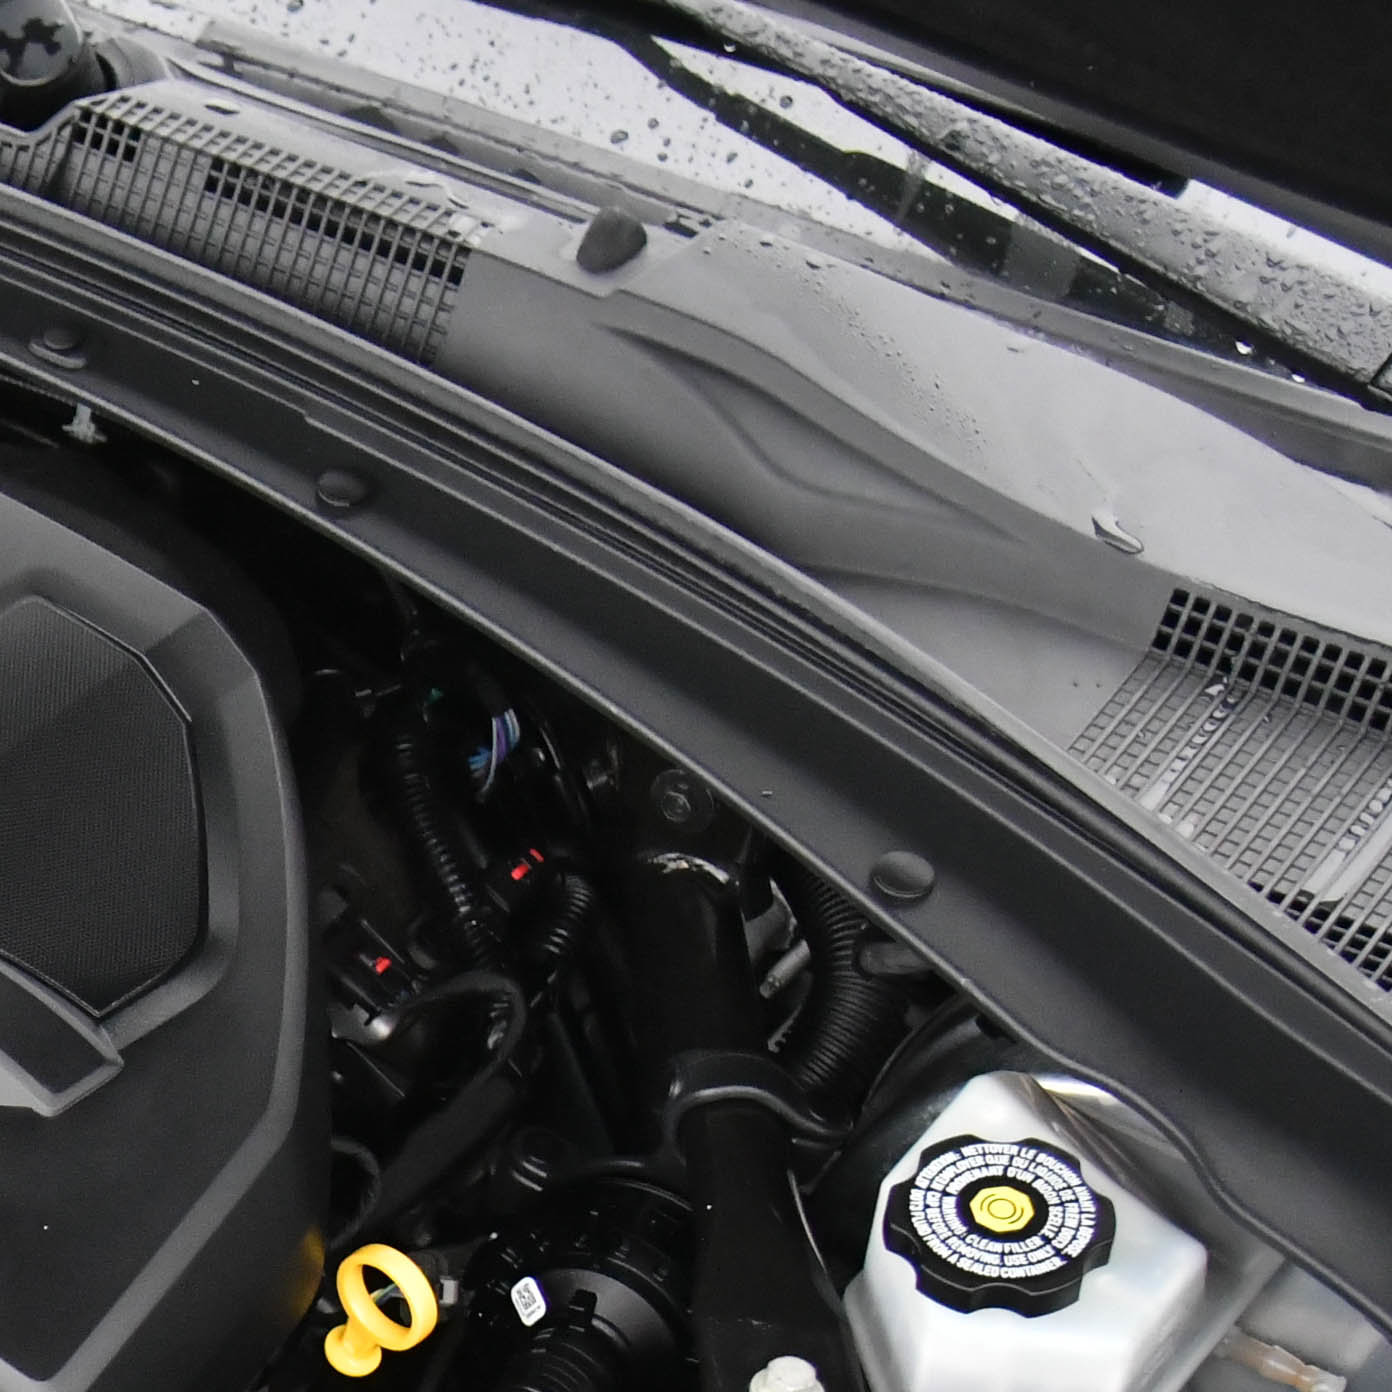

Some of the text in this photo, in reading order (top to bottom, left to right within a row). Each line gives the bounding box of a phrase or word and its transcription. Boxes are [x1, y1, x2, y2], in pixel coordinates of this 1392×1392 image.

[960, 1142, 1020, 1157] NETTOYER
[1019, 1147, 1038, 1160] LE
[985, 1154, 1011, 1166] QUE
[1011, 1156, 1030, 1170] DU
[1028, 1162, 1068, 1190] LIQUIDE
[1035, 1153, 1083, 1187] BOUCHON
[945, 1165, 1005, 1195] PROVENANT
[1007, 1167, 1036, 1183] D'UN
[1032, 1179, 1062, 1205] BIDON
[925, 1191, 943, 1207] CAP
[1059, 1189, 1076, 1201] DE
[1072, 1186, 1096, 1212] AVANT
[925, 1208, 954, 1240] BEFORE
[1064, 1203, 1081, 1228] FREIN
[1080, 1213, 1096, 1226] LA
[910, 1211, 933, 1236] FLUID
[923, 1234, 954, 1258] FROM
[947, 1253, 960, 1264] A
[956, 1257, 1000, 1277] SEALED
[963, 1234, 1003, 1253] CLEAN
[1004, 1236, 1044, 1253] FILLER
[1003, 1253, 1030, 1266] USE
[1026, 1245, 1055, 1263] ONLY
